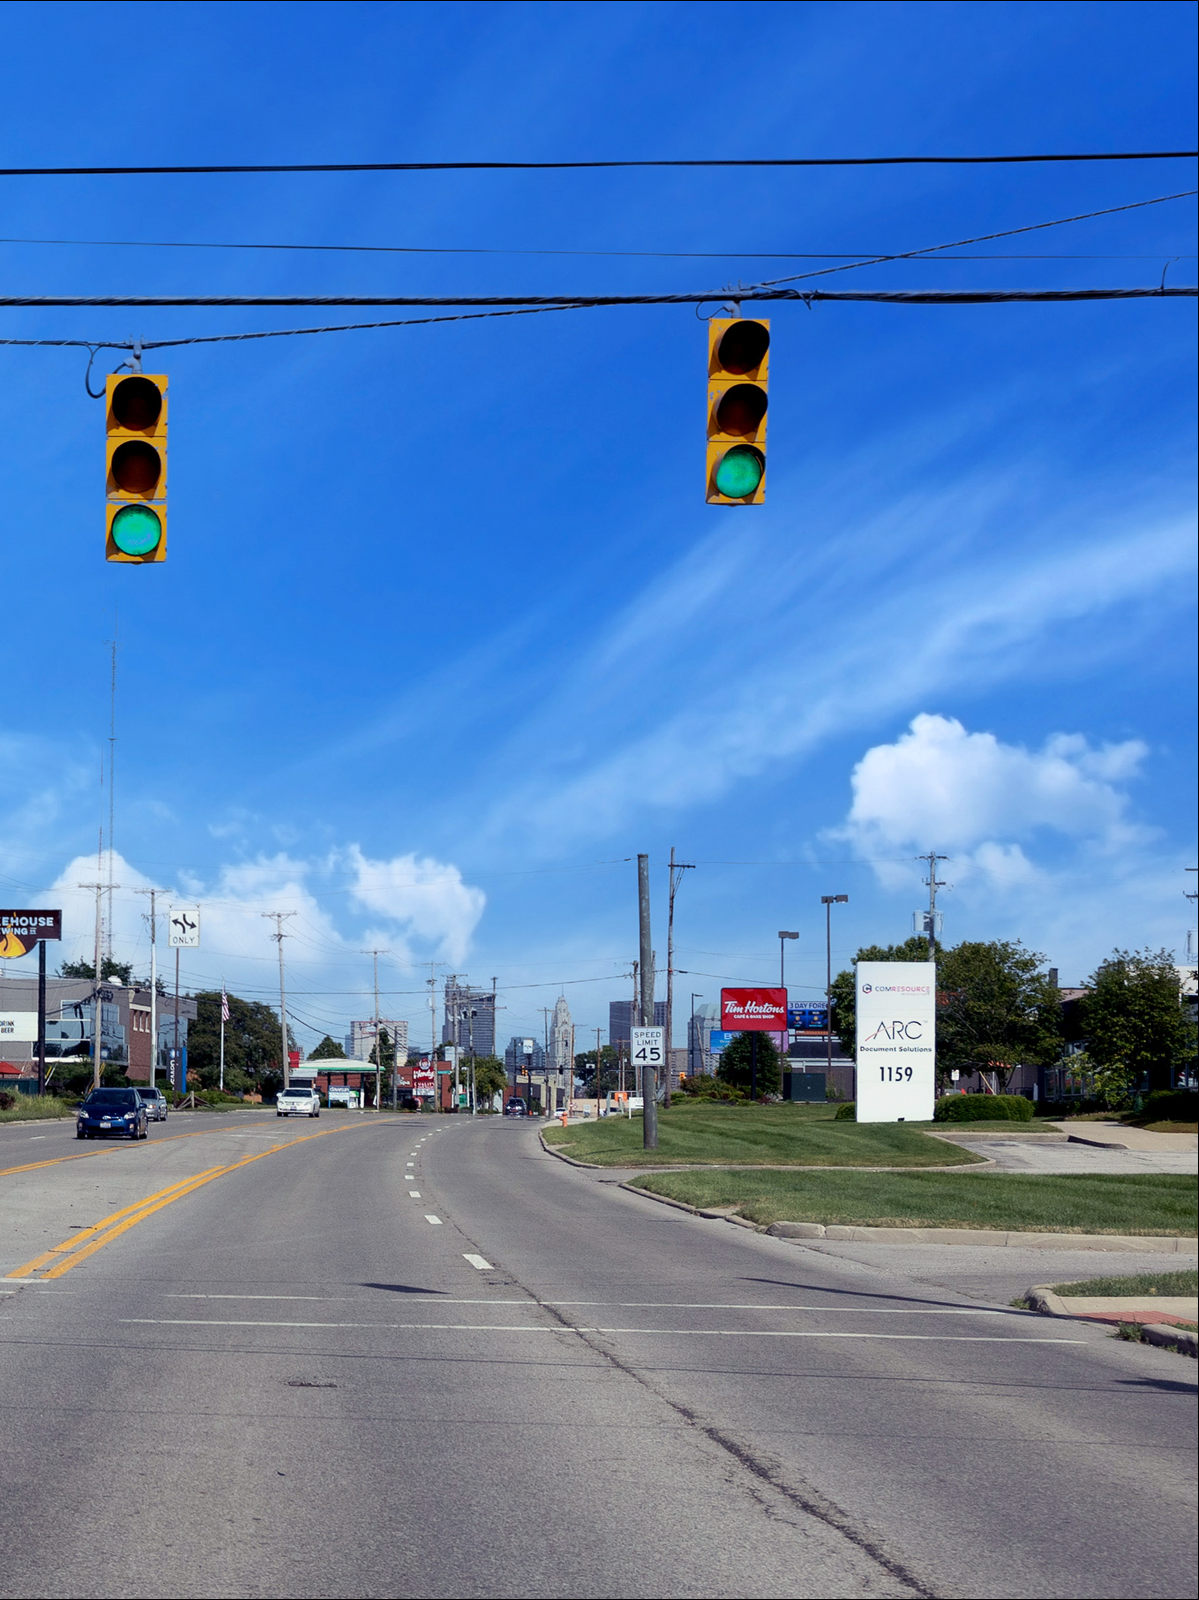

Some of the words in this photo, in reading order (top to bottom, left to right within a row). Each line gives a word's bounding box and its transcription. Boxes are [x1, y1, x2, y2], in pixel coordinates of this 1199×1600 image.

[172, 936, 195, 944] ONLY
[724, 1000, 744, 1013] Tim
[744, 1000, 785, 1013] Hortons
[865, 1021, 922, 1041] ARC
[635, 1047, 661, 1061] 45
[880, 1066, 913, 1082] 1159
